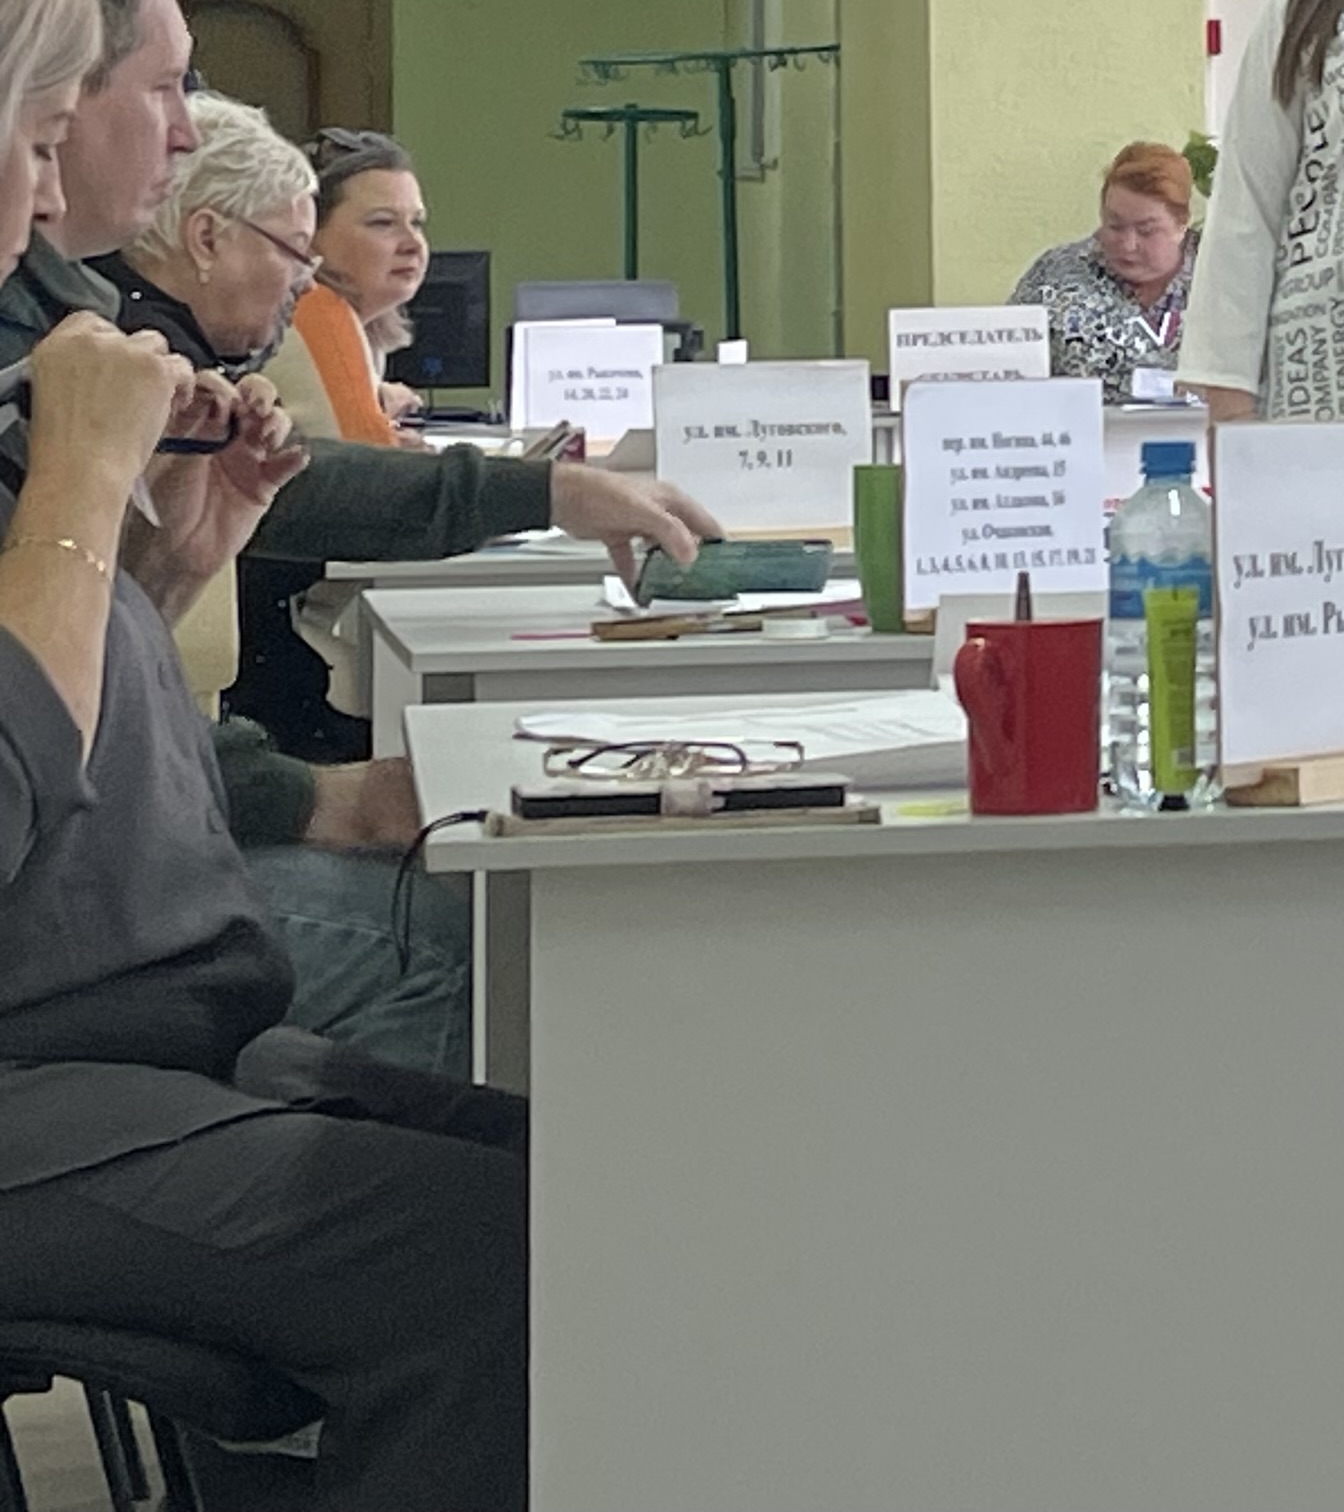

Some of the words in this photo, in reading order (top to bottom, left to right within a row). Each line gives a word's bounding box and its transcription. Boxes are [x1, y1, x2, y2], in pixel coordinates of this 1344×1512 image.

[896, 327, 1043, 347] ПРЕДСЕДАТЕЛЬ
[1286, 327, 1311, 416] IDEAS
[1310, 325, 1335, 423] OMPANY
[683, 425, 709, 445] ул.
[714, 424, 742, 439] им.
[776, 448, 793, 468] 11
[1233, 553, 1265, 589] ул.
[1269, 551, 1304, 578] им.
[1247, 615, 1279, 652] ул.
[1283, 612, 1317, 638] им.
